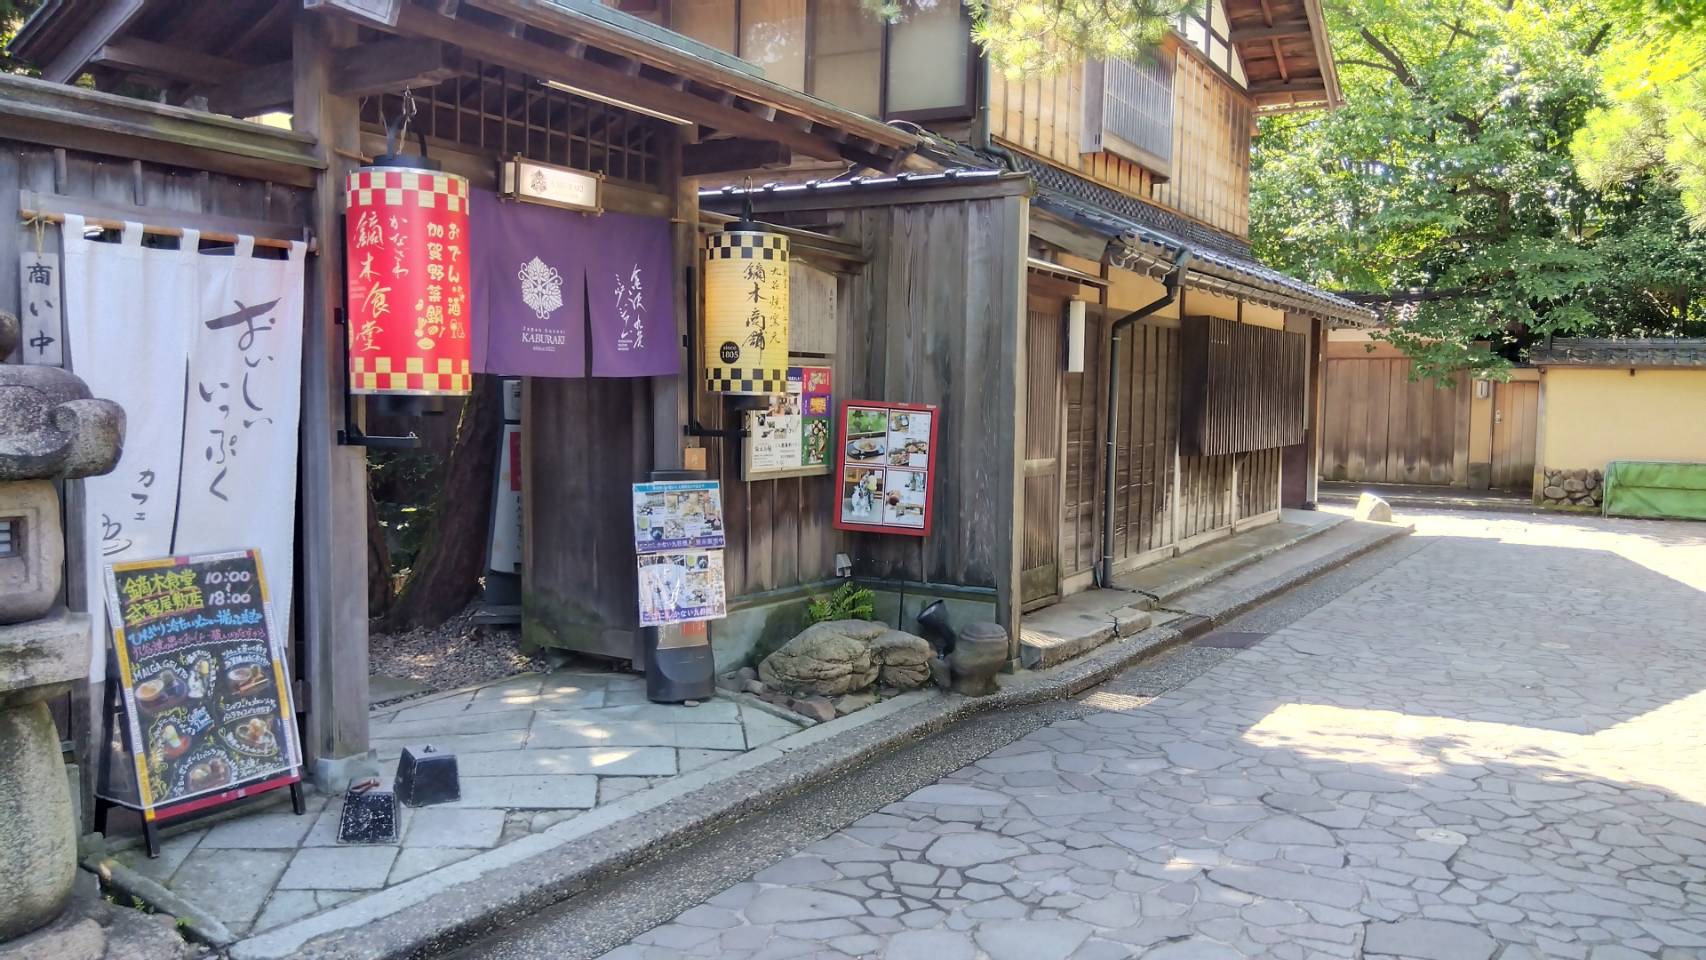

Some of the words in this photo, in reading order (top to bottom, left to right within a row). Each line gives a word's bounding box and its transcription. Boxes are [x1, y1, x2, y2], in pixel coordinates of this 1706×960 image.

[353, 211, 392, 351] 鏑木食堂
[27, 262, 56, 355] 商い中
[521, 332, 566, 345] KABURAKI
[205, 297, 282, 430] おいしい
[199, 381, 238, 501] いっぷく
[131, 469, 155, 521] カフェ
[122, 568, 197, 599] 鏑木食堂
[204, 571, 251, 584] 10:00
[208, 591, 252, 606] 18:00
[126, 591, 205, 626] 武家屋敷店
